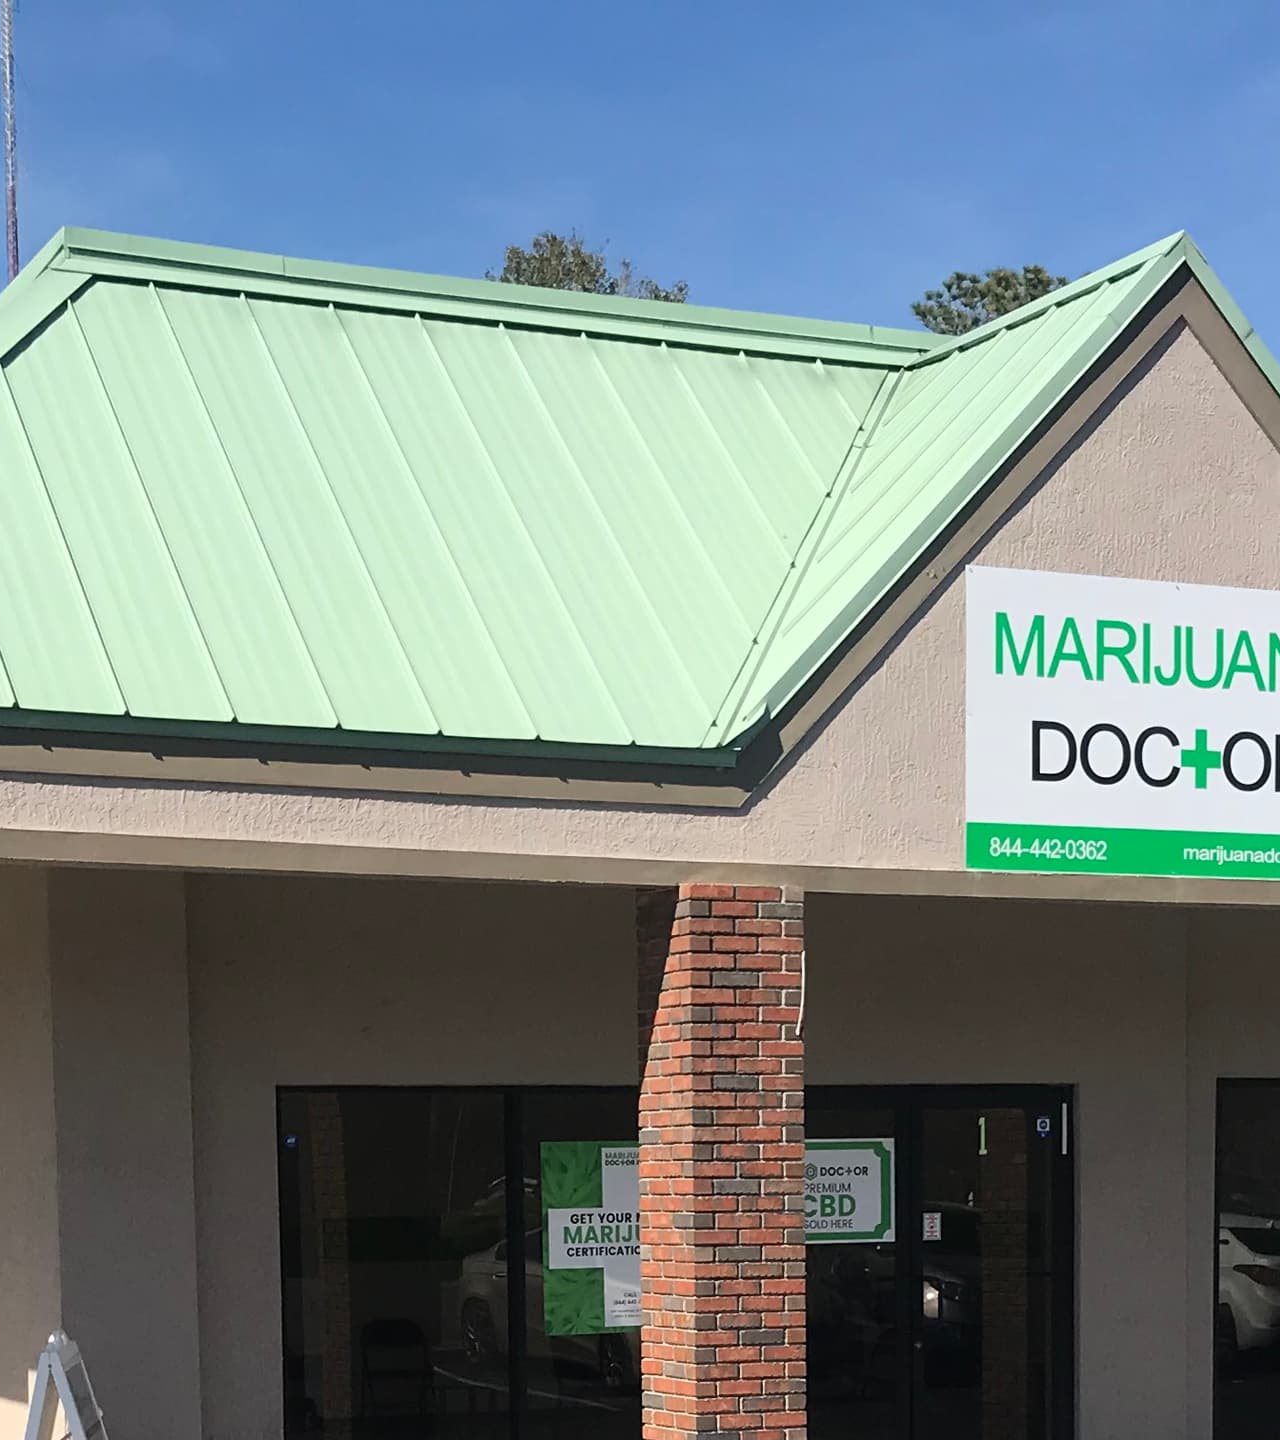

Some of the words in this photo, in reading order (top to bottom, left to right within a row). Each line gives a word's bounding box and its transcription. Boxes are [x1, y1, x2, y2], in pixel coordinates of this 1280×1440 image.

[989, 836, 1108, 862] 844-442-0362
[978, 1117, 988, 1155] 1
[805, 1183, 852, 1193] PREMIUM
[805, 1194, 856, 1217] CBD
[570, 1213, 594, 1224] GET
[598, 1213, 632, 1224] YOUR
[831, 1219, 854, 1228] HERE
